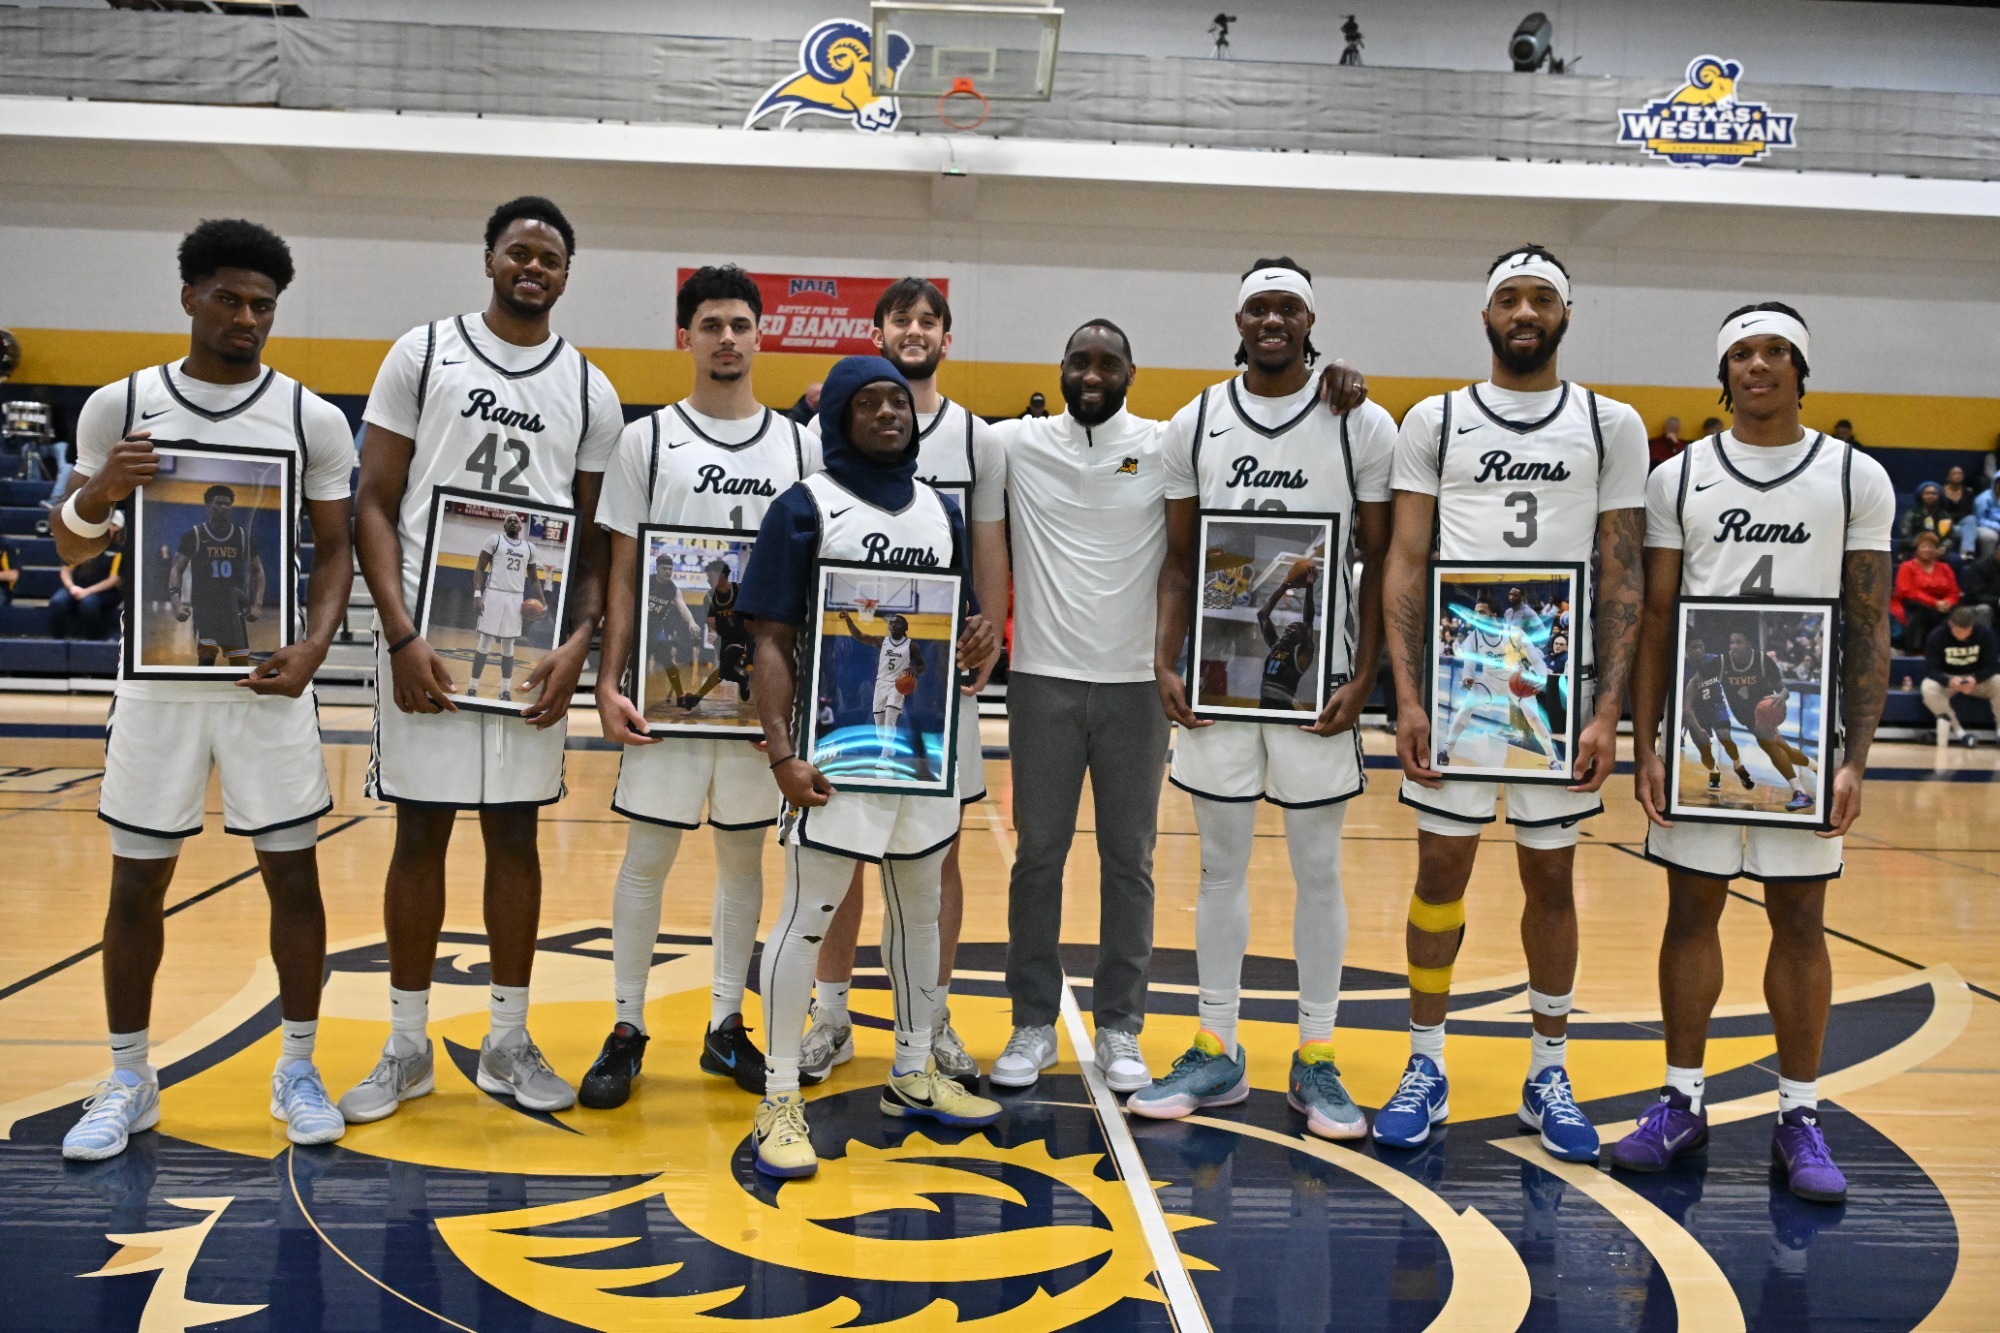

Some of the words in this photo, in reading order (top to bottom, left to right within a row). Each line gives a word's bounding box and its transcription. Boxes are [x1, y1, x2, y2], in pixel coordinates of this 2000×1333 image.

[1671, 105, 1751, 123] TEXAS
[1626, 115, 1788, 142] WESLEYAN
[789, 278, 838, 299] NAIA
[812, 306, 829, 316] FOR
[831, 307, 849, 316] THE
[758, 314, 787, 336] ED
[461, 388, 546, 433] Rams
[465, 433, 531, 496] 42
[1226, 454, 1309, 489] Rams
[1474, 449, 1571, 483] Rams
[693, 464, 777, 497] Rams
[1503, 491, 1538, 548] 3
[1713, 508, 1811, 544] Rams
[207, 546, 238, 559] TXWES
[506, 547, 524, 558] Rams
[862, 532, 940, 567] Rams
[211, 560, 232, 578] 10
[507, 558, 521, 571] 23
[1739, 554, 1774, 597] 4
[885, 649, 903, 658] Rams
[888, 658, 896, 670] 5
[1729, 675, 1757, 686] TXWES
[1702, 688, 1711, 700] 2
